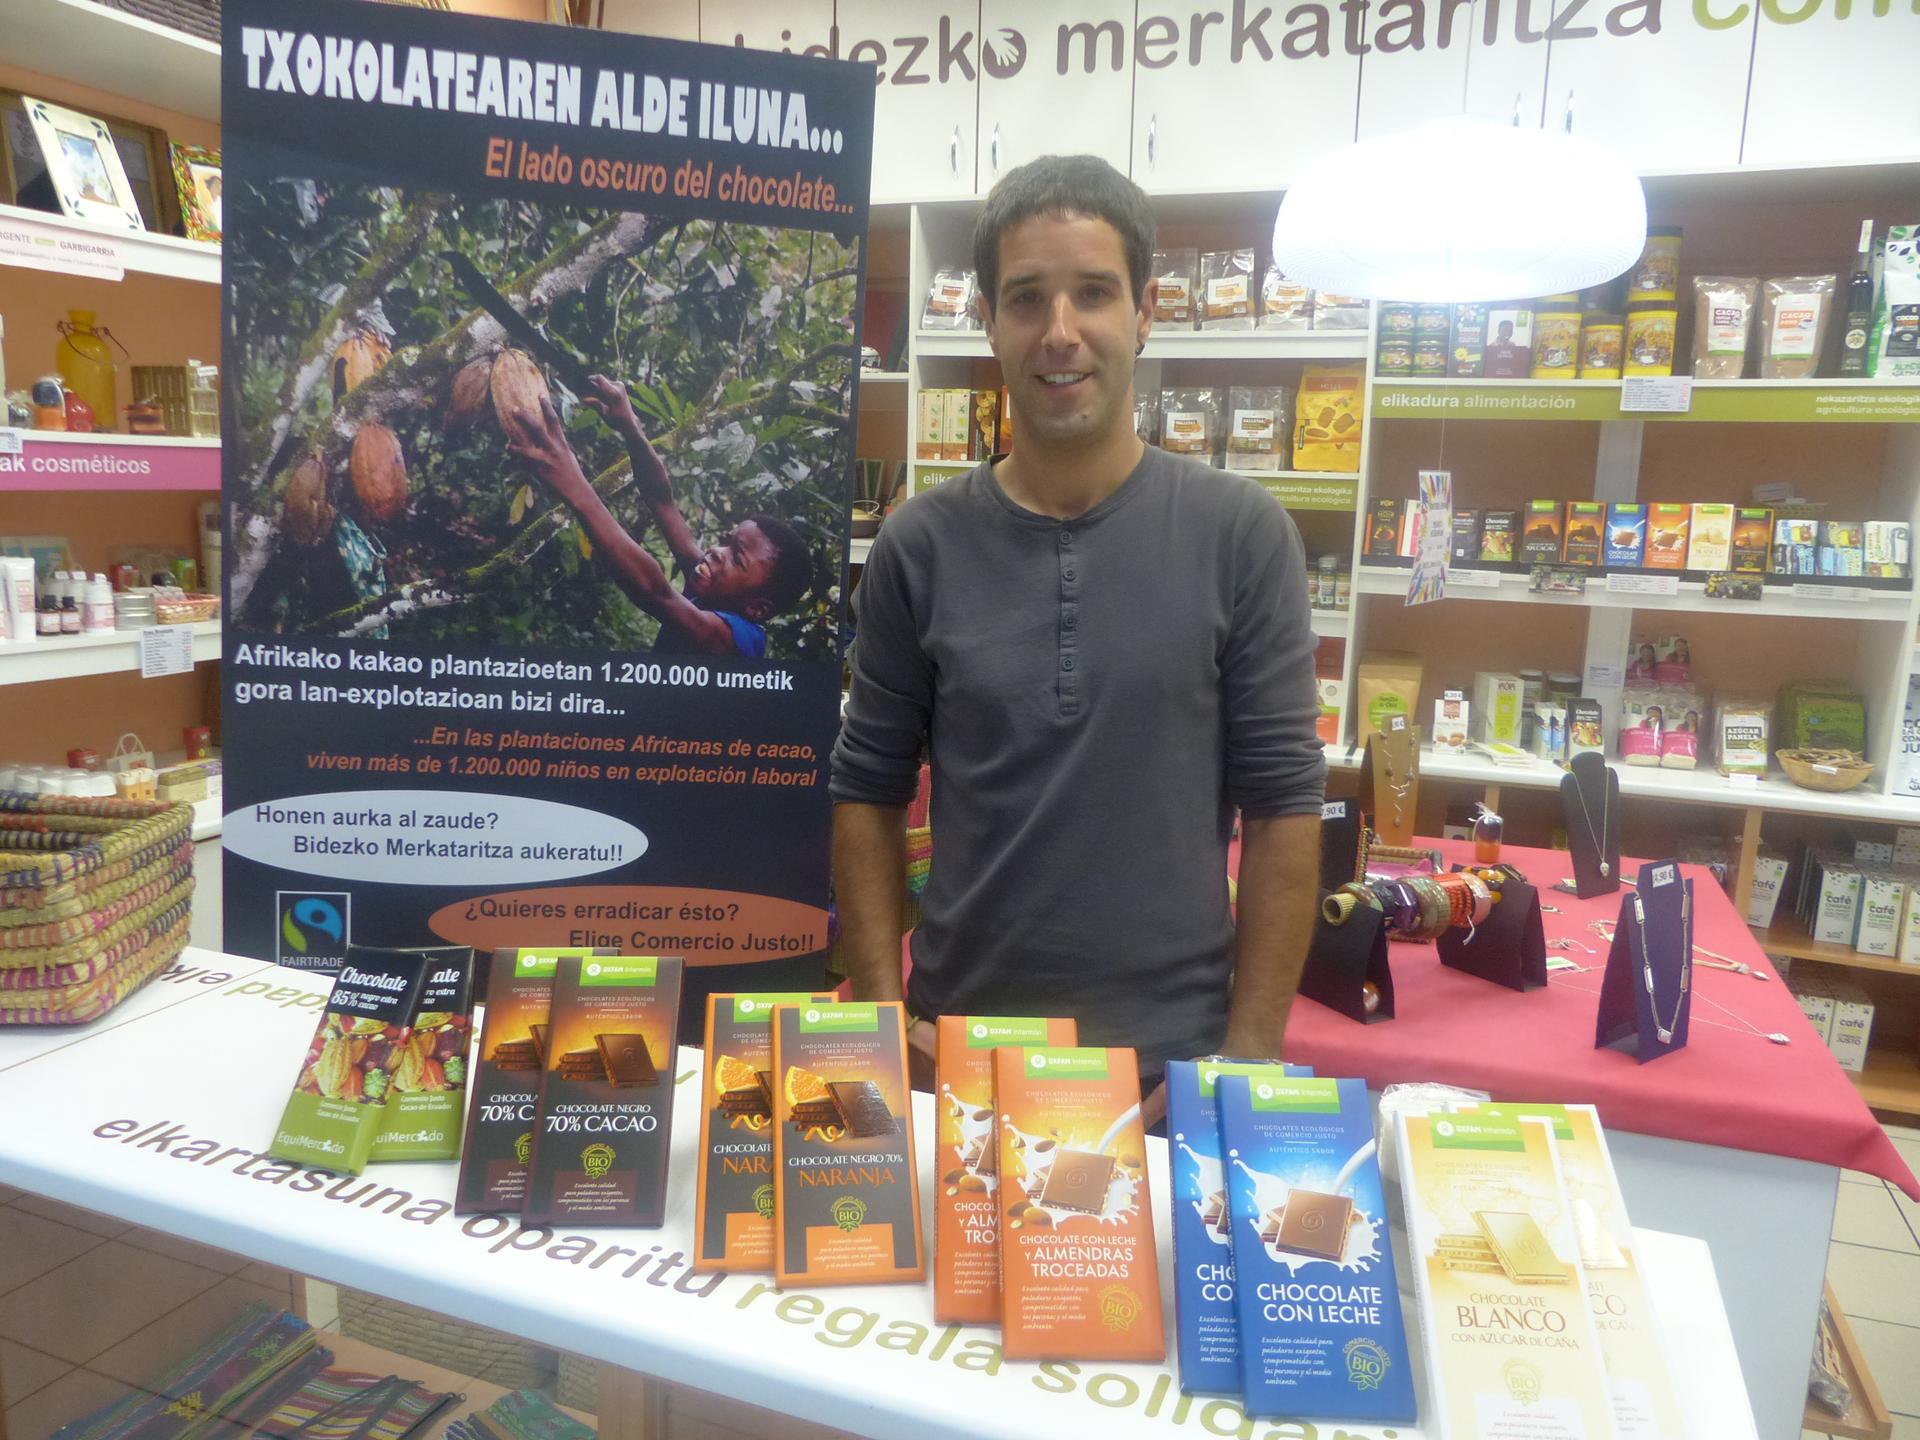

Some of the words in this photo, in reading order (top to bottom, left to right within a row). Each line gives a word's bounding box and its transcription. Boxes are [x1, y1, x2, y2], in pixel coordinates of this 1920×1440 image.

[242, 26, 580, 126] TXOKOLATEAREN
[591, 69, 688, 137] ALDE
[698, 82, 844, 155] ILUNA...
[486, 137, 511, 177] El
[517, 141, 572, 185] lado
[580, 151, 667, 194] oscuro
[673, 153, 712, 198] del
[718, 163, 855, 215] chocolate...
[1381, 394, 1459, 408] elikadura
[1464, 395, 1576, 409] alimentación
[32, 455, 151, 474] cosméticos
[235, 643, 343, 672] Afrikako
[348, 650, 423, 675] kakao
[430, 655, 593, 684] plantazioetan
[601, 661, 709, 688] 1.200.000
[716, 667, 794, 692] umetik
[235, 681, 293, 705] gora
[301, 678, 503, 712] lan-explotazioan
[511, 689, 553, 714] bizi
[560, 693, 626, 717] dira...
[464, 727, 493, 749] las
[498, 728, 626, 754] plantaciones
[630, 734, 724, 758] Africanas
[728, 740, 752, 759] de
[756, 743, 818, 763] cacao,
[306, 752, 363, 771] viven
[367, 753, 412, 774] más
[417, 755, 442, 774] de
[448, 756, 541, 779] 1.200.000
[546, 758, 600, 781] niños
[606, 765, 631, 782] en
[635, 763, 748, 787] explotación
[752, 767, 817, 789] laboral
[255, 804, 327, 828] Honen
[331, 807, 393, 829] aurka
[398, 809, 418, 830] al
[422, 810, 499, 832] zaude?
[294, 836, 379, 859] Bidezko
[385, 838, 515, 862] Merkataritza
[520, 841, 624, 864] aukeratu!!
[1825, 894, 1852, 905] café
[465, 898, 567, 923] ¿Quieres
[572, 901, 673, 923] erradicar
[679, 901, 740, 923] ésto?
[1869, 904, 1896, 915] café
[569, 929, 623, 953] Elige
[630, 930, 736, 953] Comercio
[741, 931, 815, 954] Justo!!
[281, 955, 345, 968] FAIRTRADE
[339, 967, 408, 992] Chocolate
[435, 988, 456, 996] extra
[1839, 1019, 1865, 1028] café
[480, 1105, 516, 1122] 70%
[555, 1104, 615, 1114] CHOCOLATE
[617, 1104, 652, 1113] NEGRO
[546, 1115, 581, 1133] 70%
[583, 1115, 657, 1132] CACAO
[587, 1157, 608, 1168] BIO
[788, 1155, 848, 1167] CHOCOLATE
[850, 1154, 884, 1166] NEGRO
[800, 1168, 896, 1189] NARANJA
[839, 1211, 860, 1222] BIO
[93, 1118, 453, 1226] elkartasuna
[460, 1214, 728, 1299] oparitu
[735, 1283, 1002, 1377] regala
[1019, 1235, 1081, 1246] CHOCOLATE
[1082, 1235, 1106, 1246] CON
[1107, 1235, 1138, 1246] LECHE
[1025, 1251, 1032, 1261] Y
[1034, 1246, 1134, 1263] ALMENDRAS
[1031, 1263, 1130, 1279] TROCEADAS
[1255, 1283, 1383, 1305] CHOCOLATE
[1469, 1293, 1547, 1308] CHOCOLATE
[1106, 1302, 1132, 1319] BIO
[1263, 1303, 1314, 1323] CON
[1318, 1304, 1382, 1325] LECHE
[1457, 1305, 1567, 1334] BLANCO
[1451, 1333, 1477, 1345] CON
[1478, 1330, 1528, 1347] AZÚCAR
[1545, 1334, 1581, 1351] CAÑA
[1351, 1356, 1380, 1376] BIO
